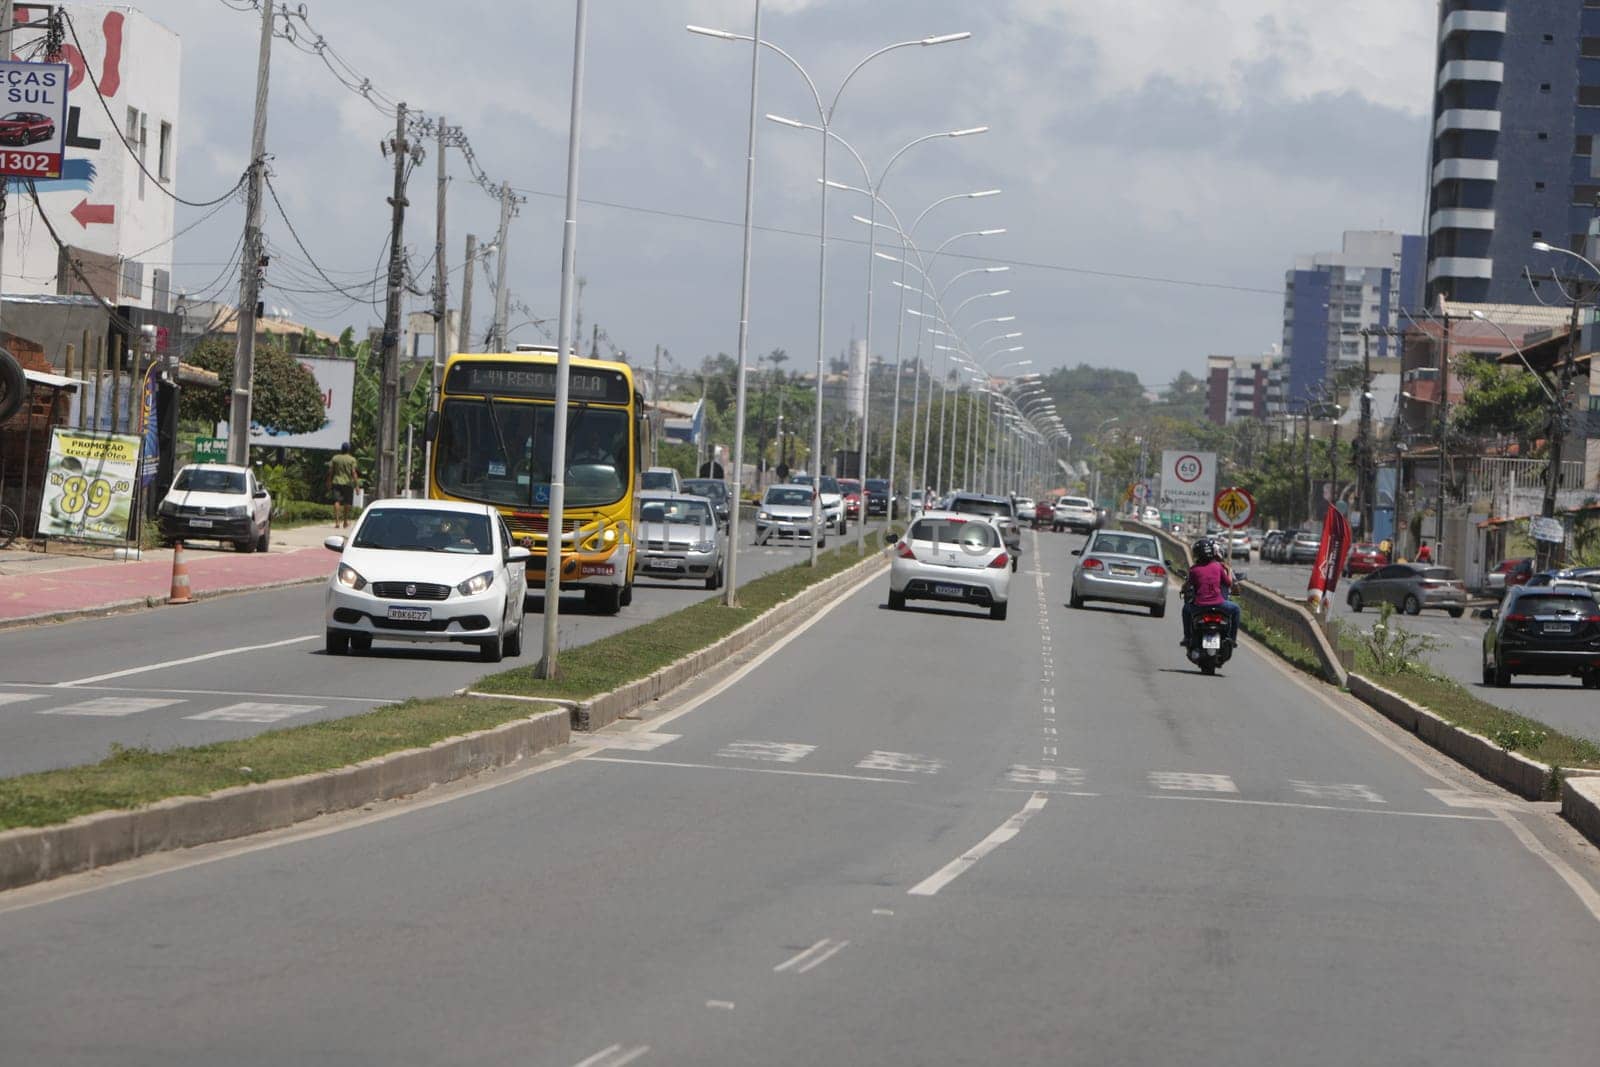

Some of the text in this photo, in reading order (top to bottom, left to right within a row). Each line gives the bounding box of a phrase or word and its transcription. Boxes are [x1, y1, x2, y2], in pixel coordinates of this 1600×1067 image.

[8, 89, 55, 104] SUL
[0, 153, 49, 171] 1302
[72, 440, 124, 452] PROMOÇÃO
[1181, 463, 1196, 473] 60
